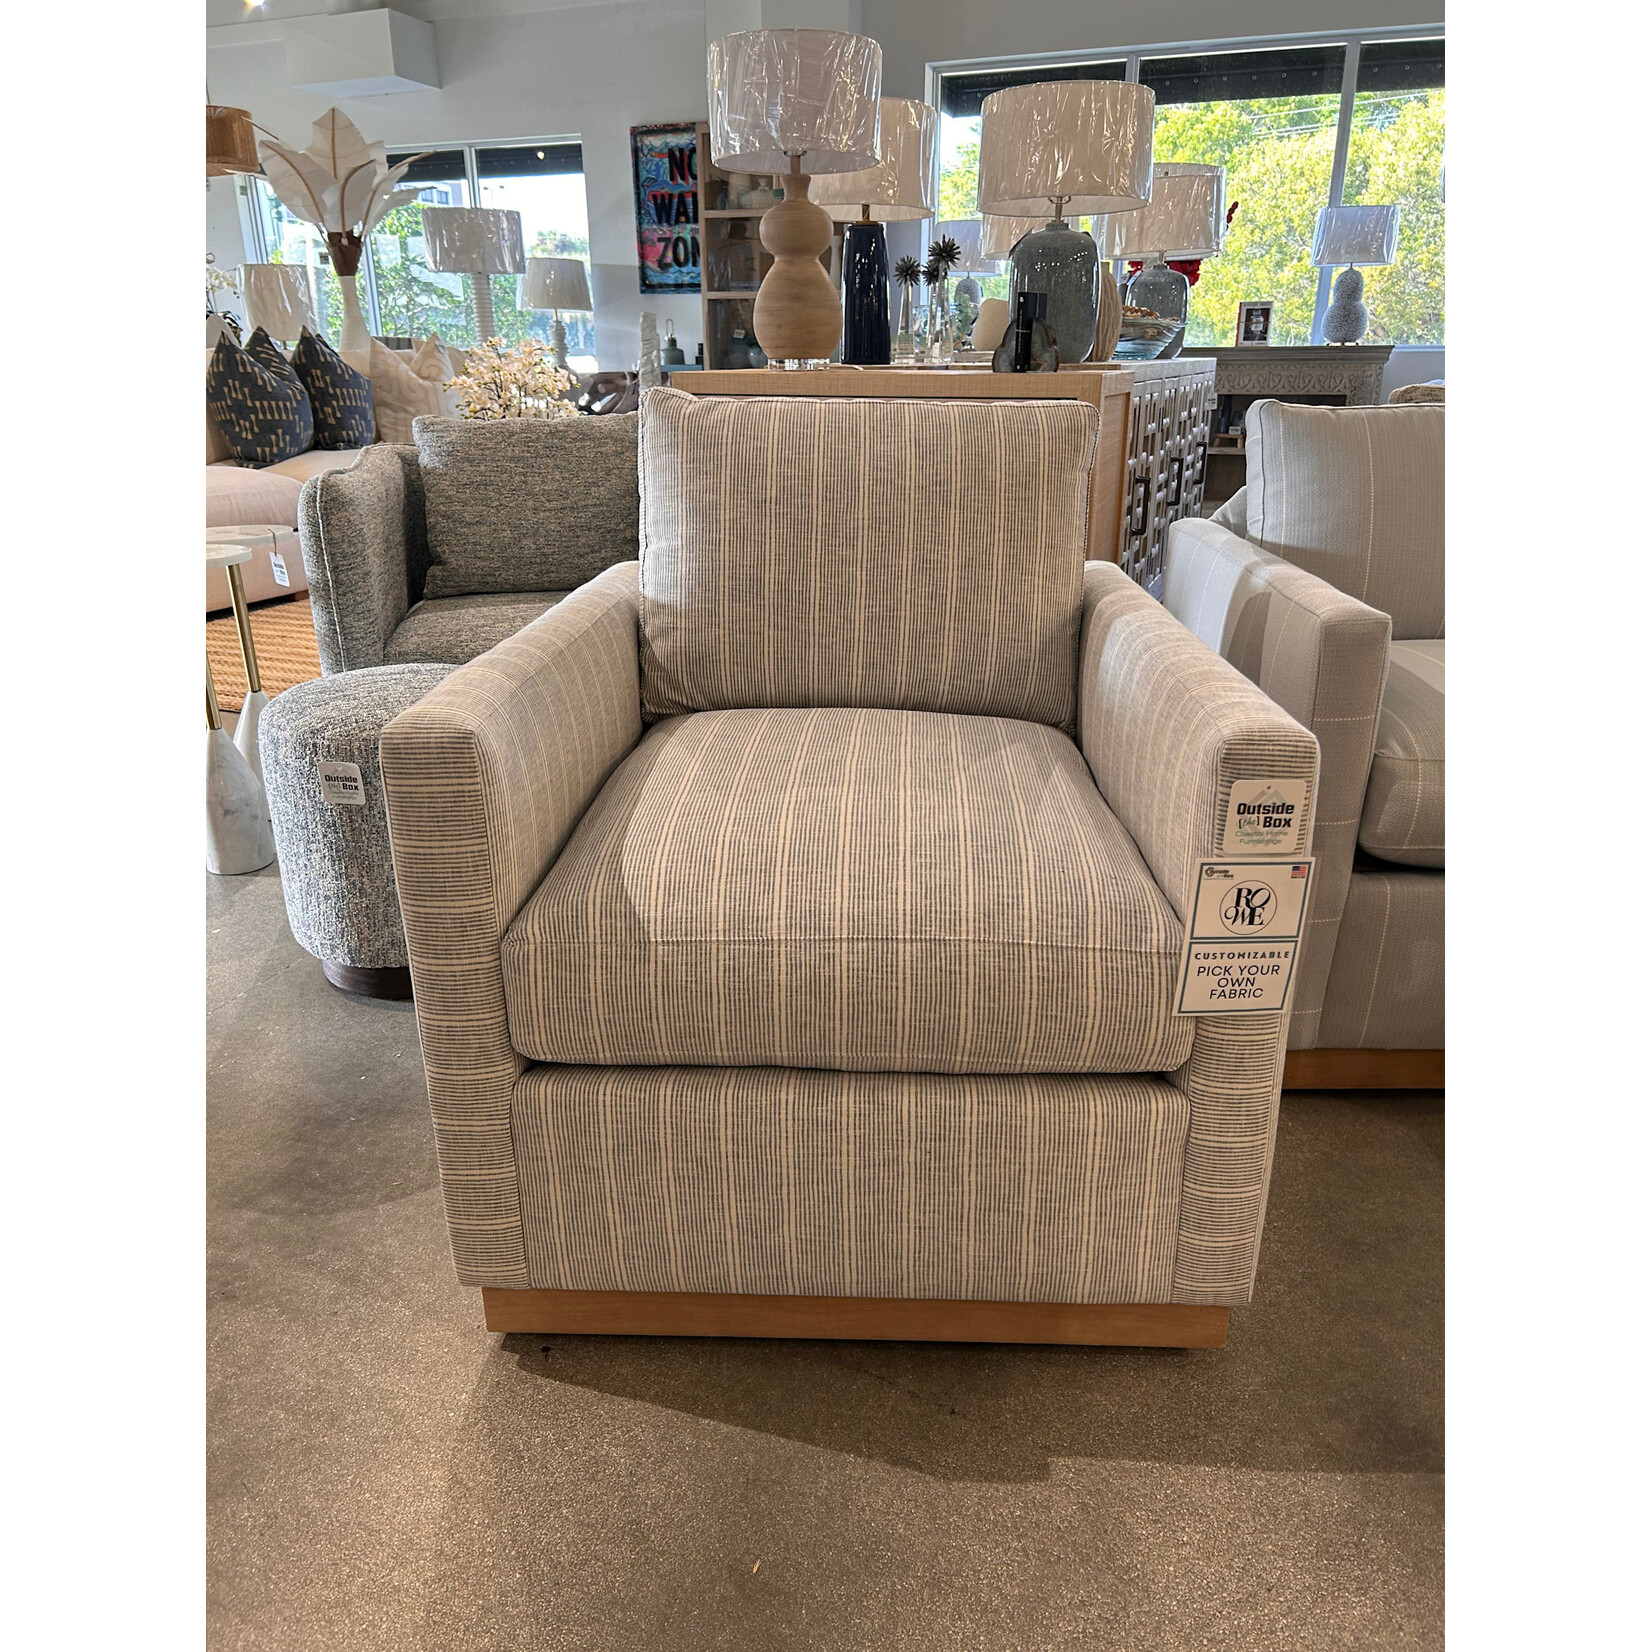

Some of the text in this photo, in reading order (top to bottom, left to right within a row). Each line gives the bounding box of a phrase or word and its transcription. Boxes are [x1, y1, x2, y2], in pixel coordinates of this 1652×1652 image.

[325, 775, 358, 783] Outside
[342, 782, 359, 791] Box
[1236, 802, 1295, 815] Outside
[1262, 816, 1292, 828] Box
[1194, 951, 1290, 960] CUSTOMIZABLE
[1196, 965, 1281, 977] PICK YOUR
[1217, 977, 1256, 988] OWN
[1209, 988, 1264, 999] FABRIC
